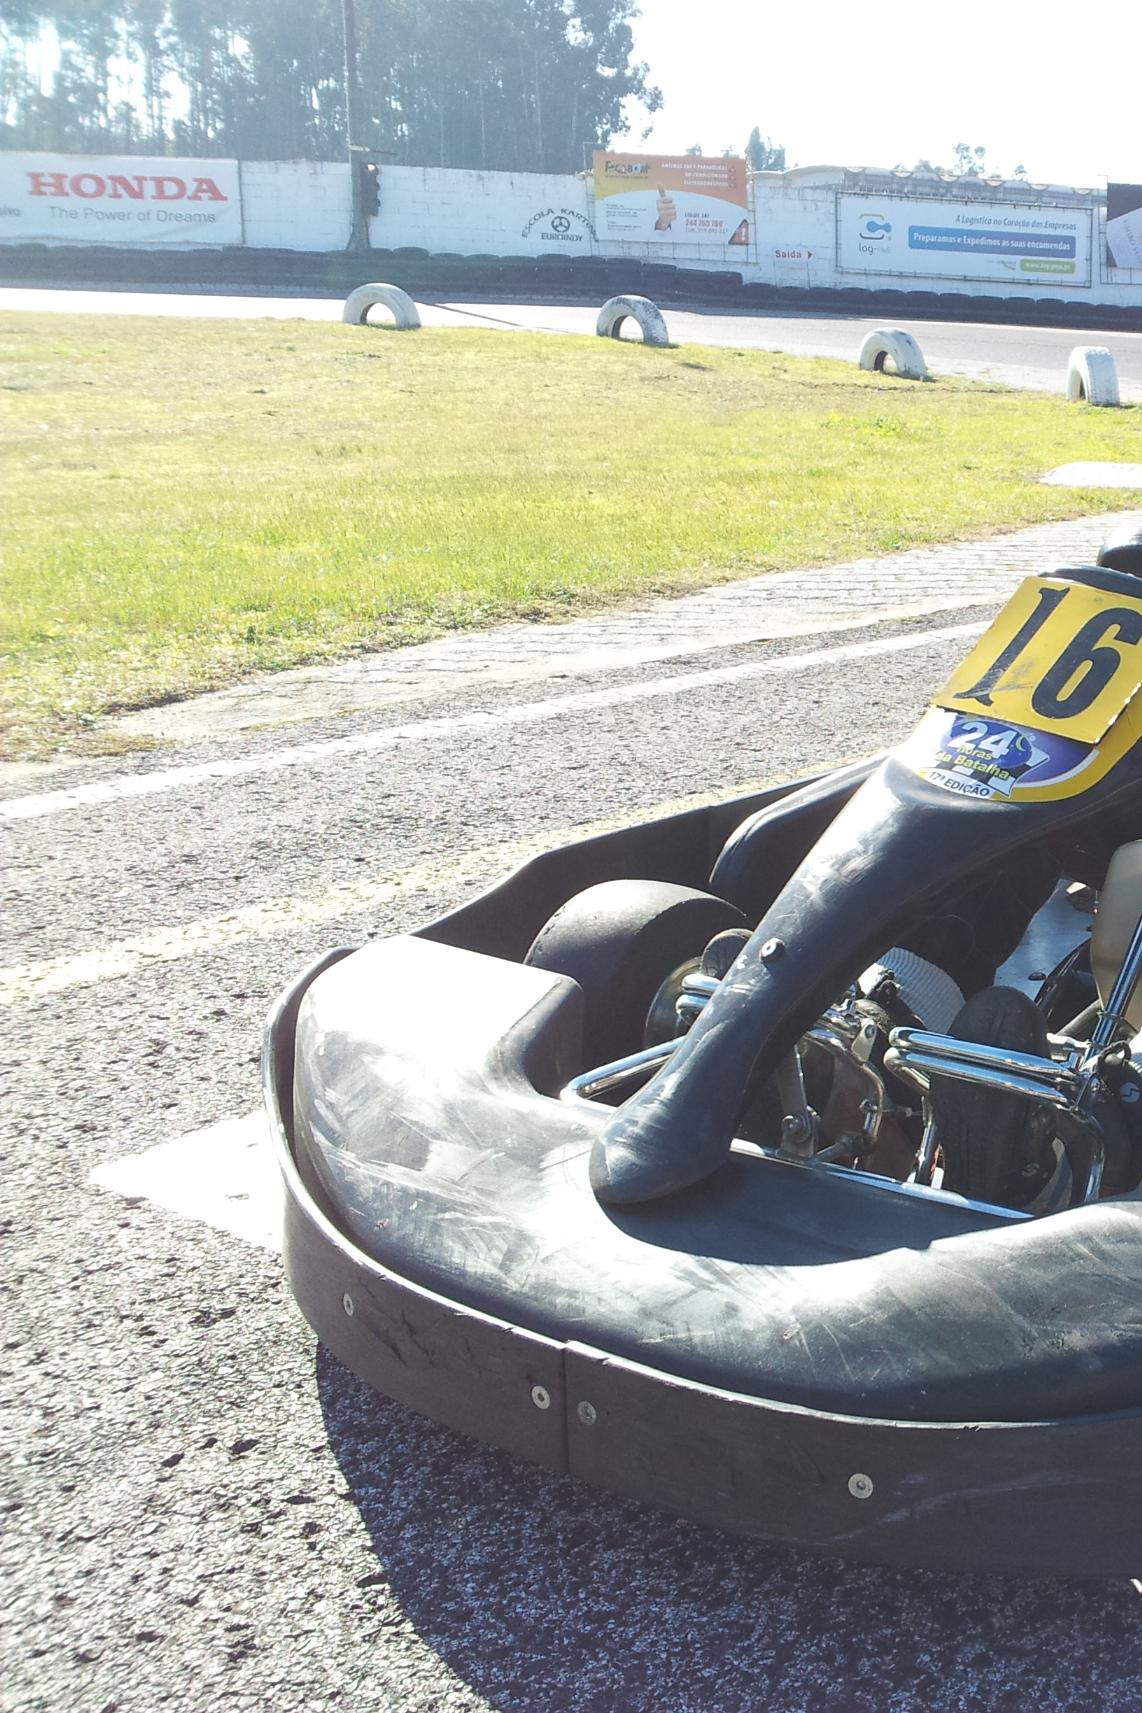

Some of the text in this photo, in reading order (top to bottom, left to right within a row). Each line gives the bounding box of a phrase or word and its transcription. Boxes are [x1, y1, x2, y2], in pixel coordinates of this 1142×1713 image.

[27, 172, 228, 201] HONDA
[49, 206, 216, 223] The Power of Dreams
[521, 208, 554, 238] ESCOLA
[913, 232, 957, 244] Preparamos
[963, 235, 1000, 247] Expedimos
[1010, 240, 1026, 248] suas
[1027, 240, 1071, 251] encomendas
[947, 721, 1018, 759] 24
[935, 750, 1010, 779] da Batalha
[943, 777, 990, 796] EDIÇÃO
